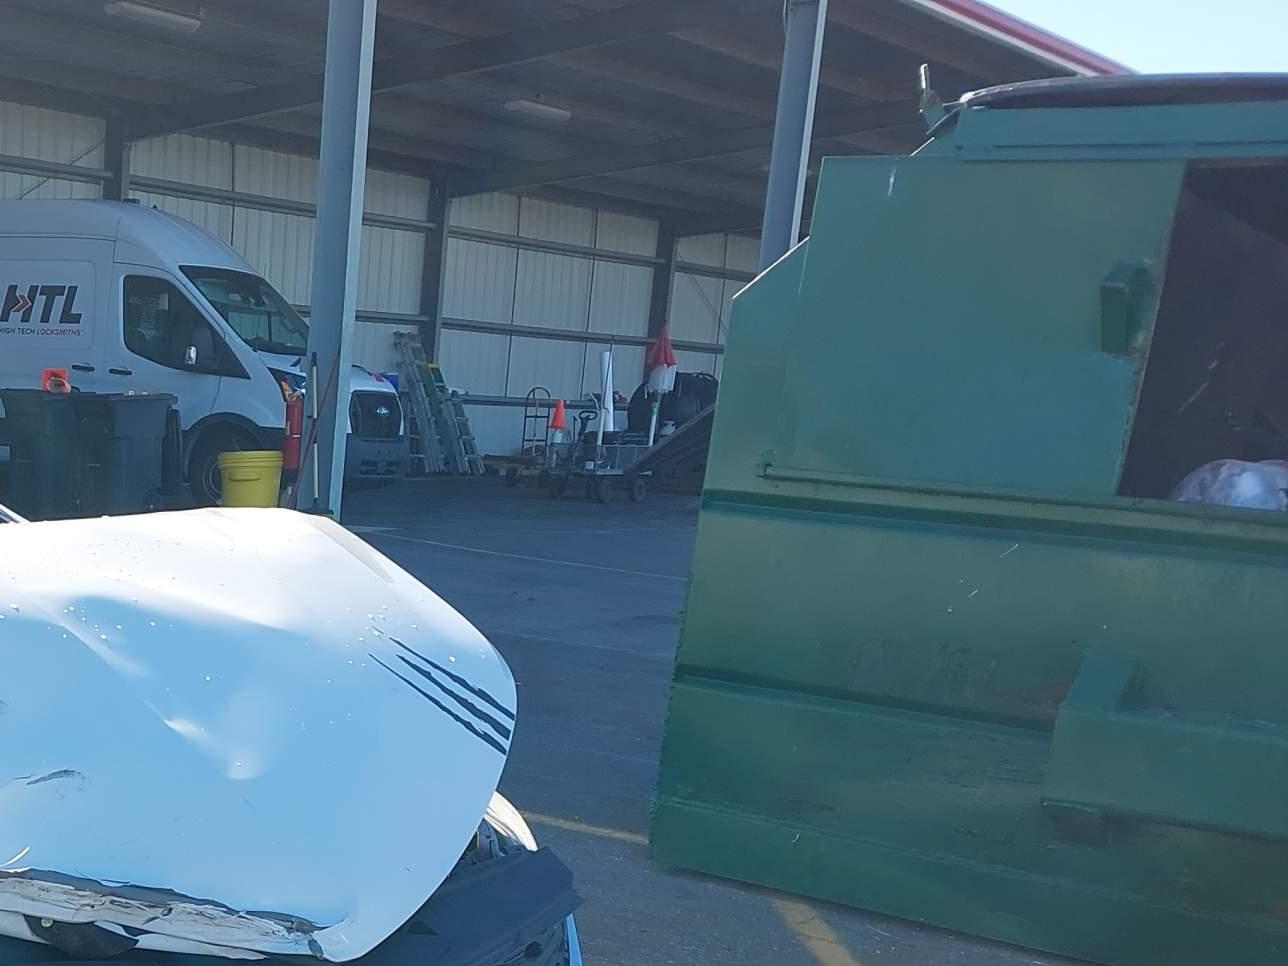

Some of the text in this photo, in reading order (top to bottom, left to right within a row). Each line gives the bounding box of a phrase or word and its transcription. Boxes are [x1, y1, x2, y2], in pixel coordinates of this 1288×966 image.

[0, 284, 83, 324] HTL
[0, 327, 81, 337] HIGH TECH LOCKSMITHS
